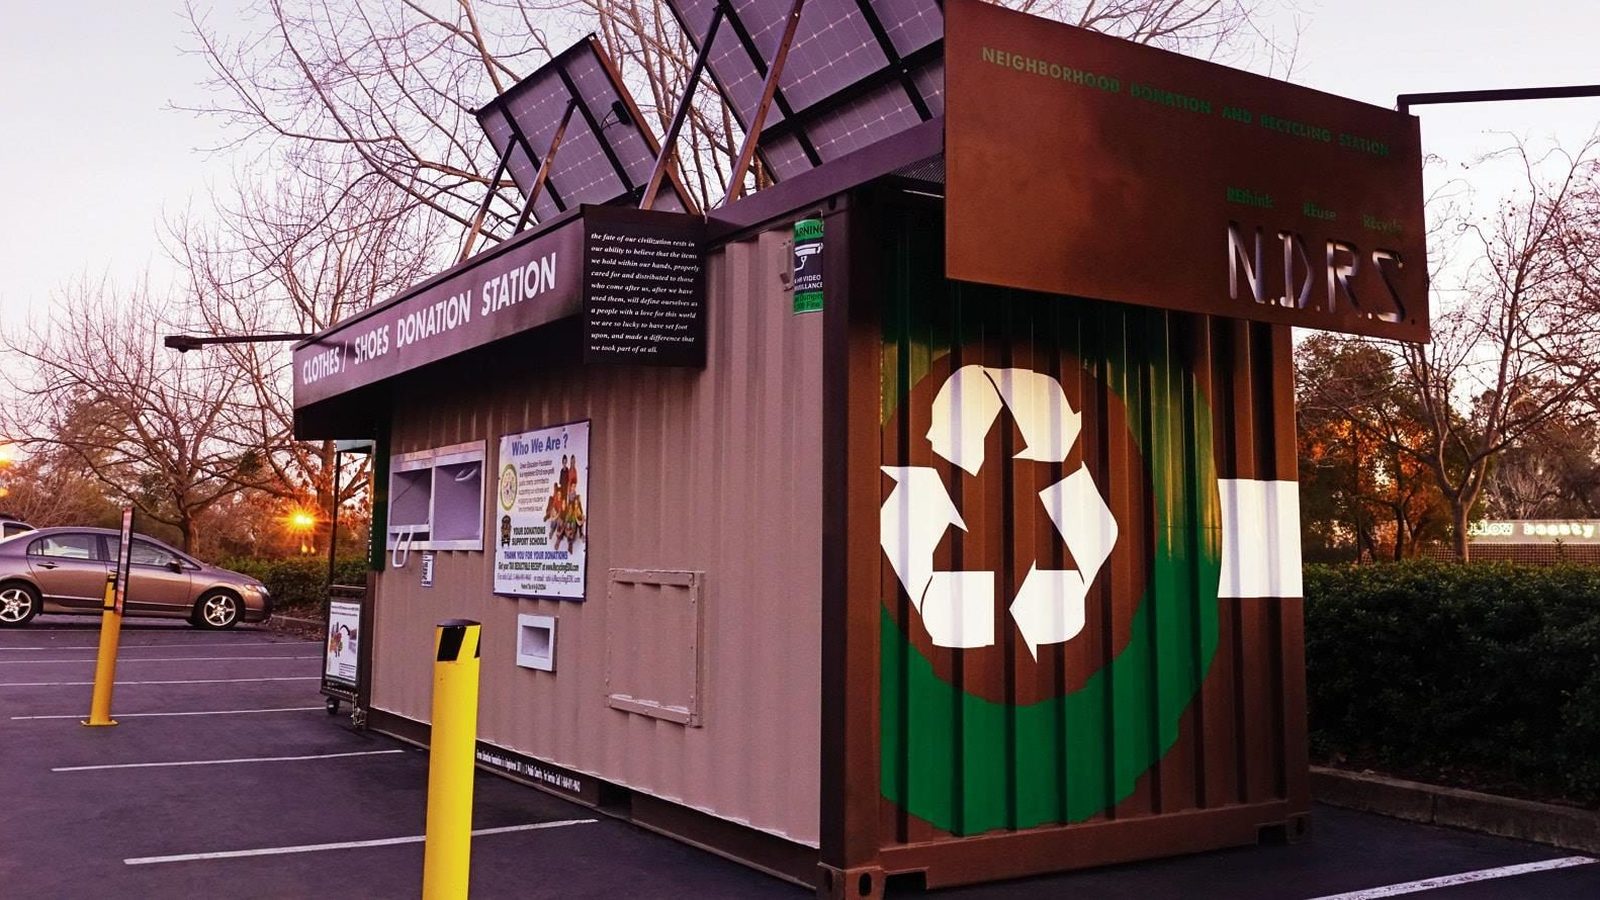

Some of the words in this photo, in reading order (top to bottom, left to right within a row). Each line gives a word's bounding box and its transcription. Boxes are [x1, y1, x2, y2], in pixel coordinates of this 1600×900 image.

[982, 47, 1120, 93] NEIGHBORHOOD
[1130, 82, 1212, 114] DONATION
[1222, 105, 1252, 123] AND
[1260, 114, 1332, 143] RECYCLING
[1339, 132, 1389, 156] STATION
[637, 237, 671, 245] civilization
[633, 248, 655, 256] believe
[652, 262, 672, 270] hands,
[635, 273, 669, 281] distributed
[803, 274, 821, 282] VIDEO
[624, 284, 640, 292] after
[654, 310, 665, 318] for
[303, 346, 340, 385] CLOTHES
[342, 340, 348, 372] /
[354, 324, 390, 365] SHOES
[396, 290, 472, 349] DONATION
[481, 252, 557, 317] STATION
[622, 321, 640, 329] lucky
[674, 323, 688, 331] foot
[649, 334, 681, 342] difference
[512, 441, 529, 456] Who
[531, 438, 544, 454] We
[545, 436, 561, 450] Are
[563, 433, 568, 448] ?
[513, 527, 523, 535] YOUR
[524, 526, 546, 535] DONATIONS
[512, 537, 529, 546] SUPPORT
[529, 537, 548, 546] SCHOOLS
[504, 551, 516, 559] THANK
[517, 551, 525, 559] YOU
[525, 551, 533, 559] FOR
[534, 551, 544, 560] YOUR
[545, 551, 568, 560] DONATIONS
